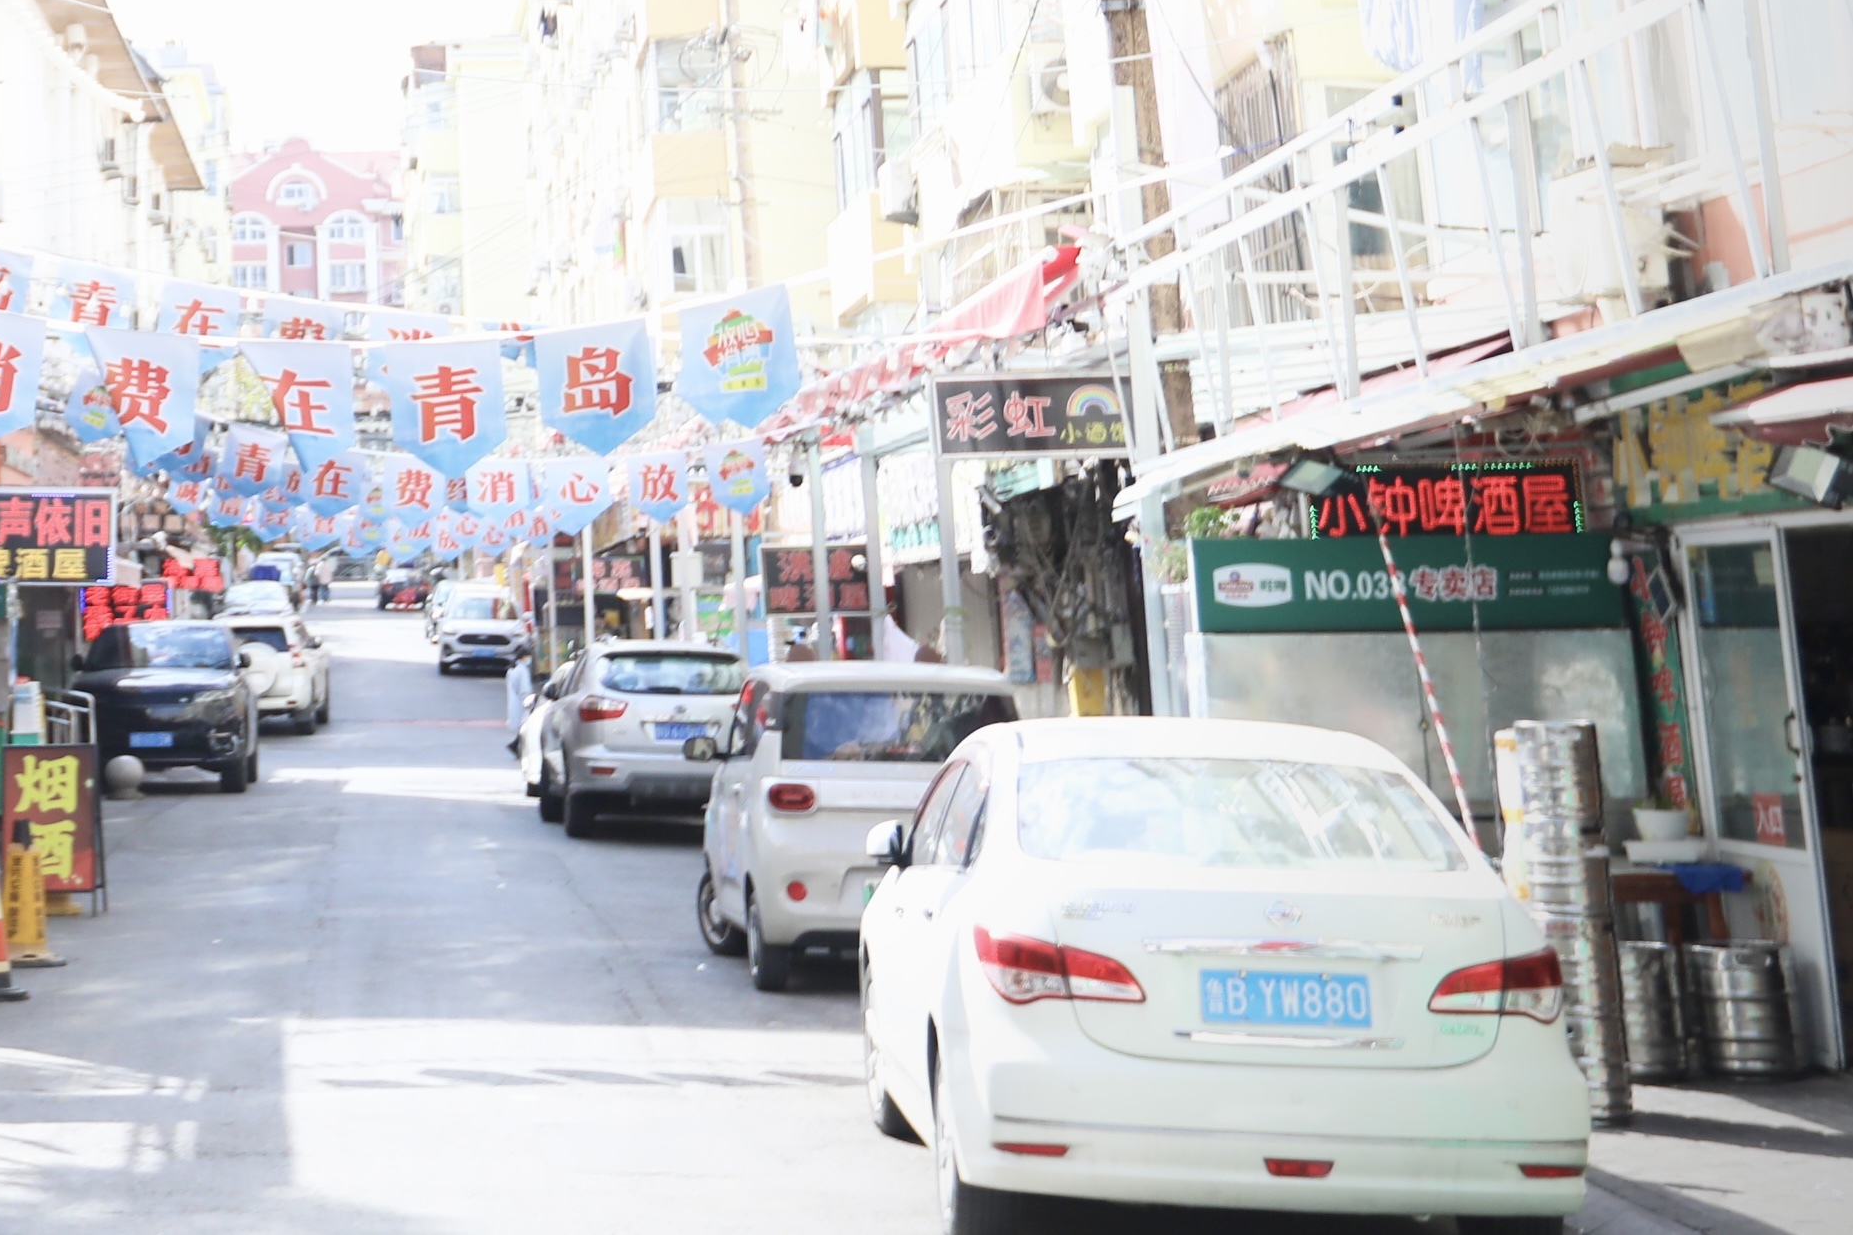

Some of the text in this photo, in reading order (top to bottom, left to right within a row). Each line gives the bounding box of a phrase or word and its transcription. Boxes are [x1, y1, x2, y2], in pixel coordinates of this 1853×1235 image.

[105, 357, 172, 435] 费
[262, 369, 335, 435] 在
[562, 346, 635, 417] 岛
[411, 364, 483, 443] 青
[945, 390, 1057, 442] 彩虹
[234, 442, 271, 483] 青
[311, 459, 354, 499] 在
[639, 462, 681, 503] 放
[395, 468, 434, 510] 费
[475, 471, 517, 504] 消
[559, 472, 601, 504] 心
[1318, 474, 1576, 538] 小钟啤酒屋
[1409, 565, 1498, 602] 专卖店
[1756, 799, 1785, 838] 入口
